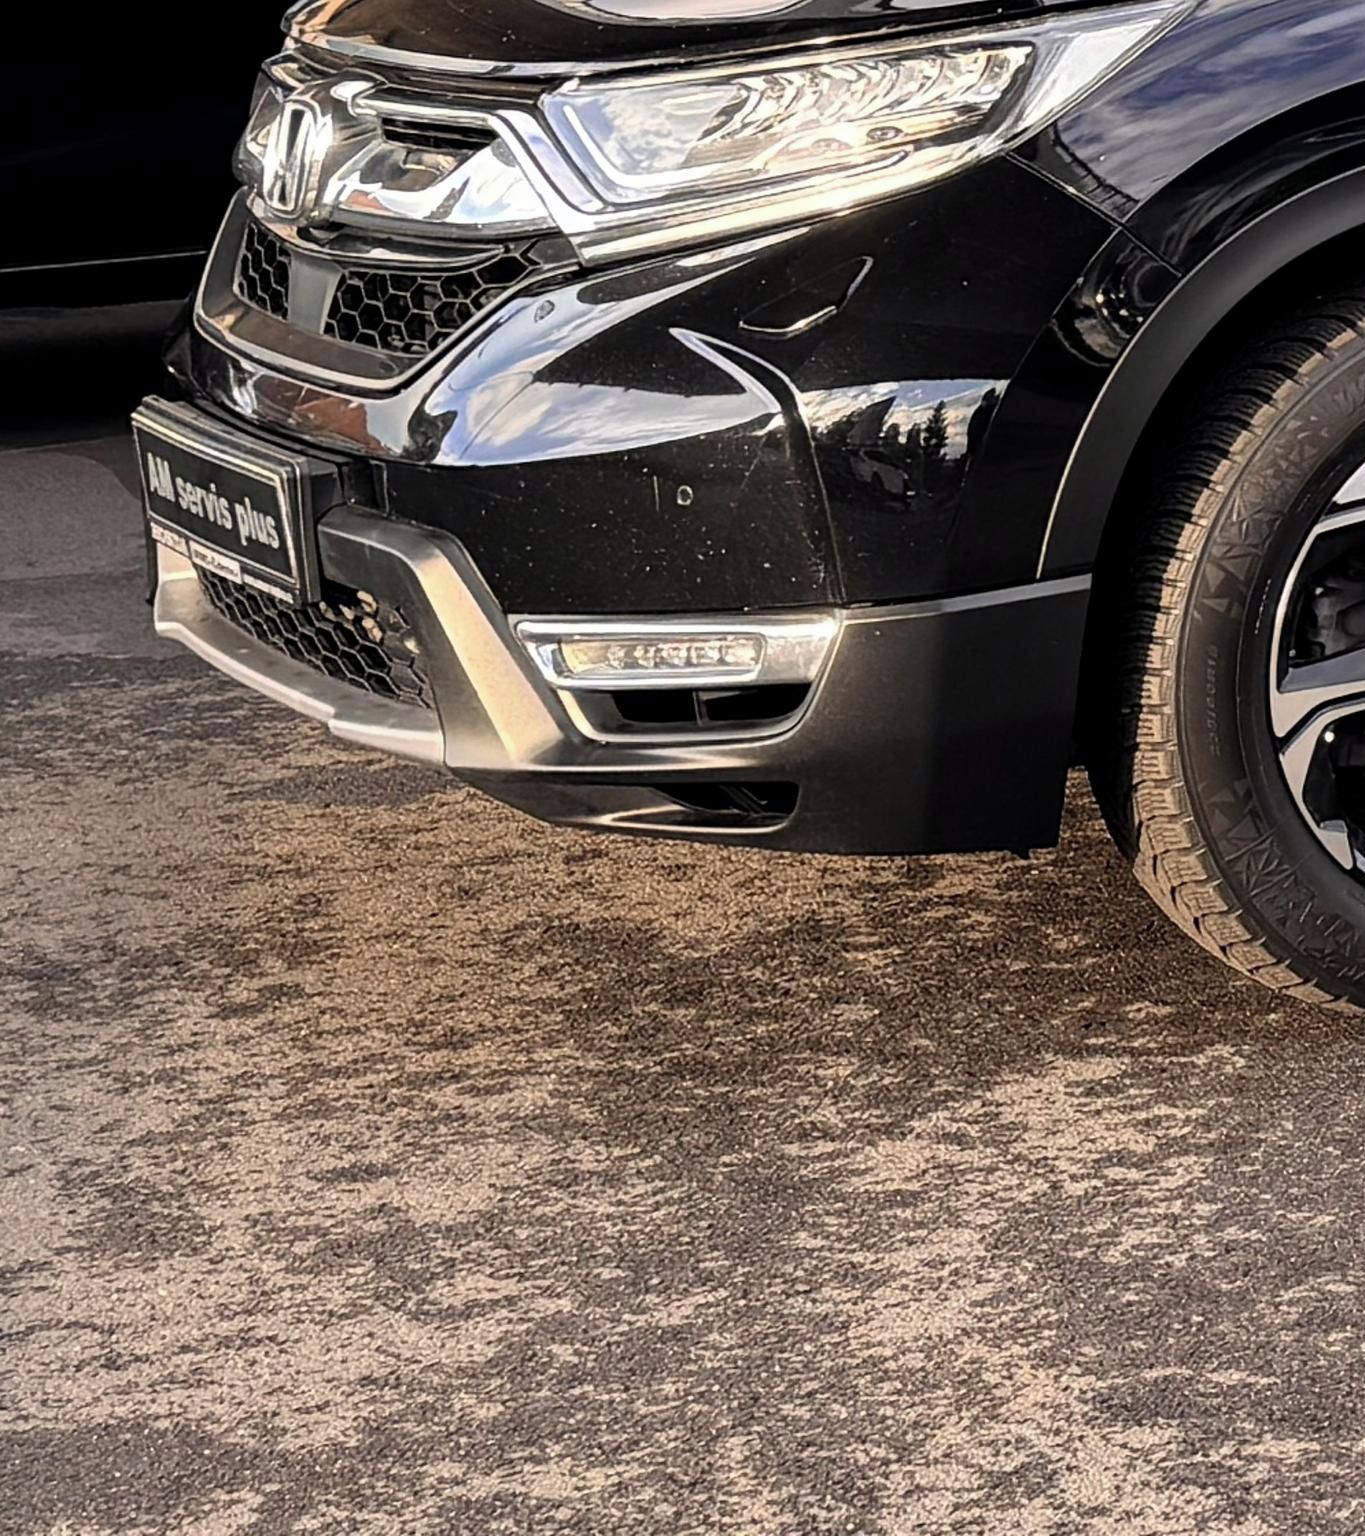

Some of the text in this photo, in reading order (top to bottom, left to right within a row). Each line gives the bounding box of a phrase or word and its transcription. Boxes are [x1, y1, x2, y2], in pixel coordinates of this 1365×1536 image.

[147, 452, 176, 502] AM
[175, 477, 232, 530] servis
[233, 497, 280, 549] plus
